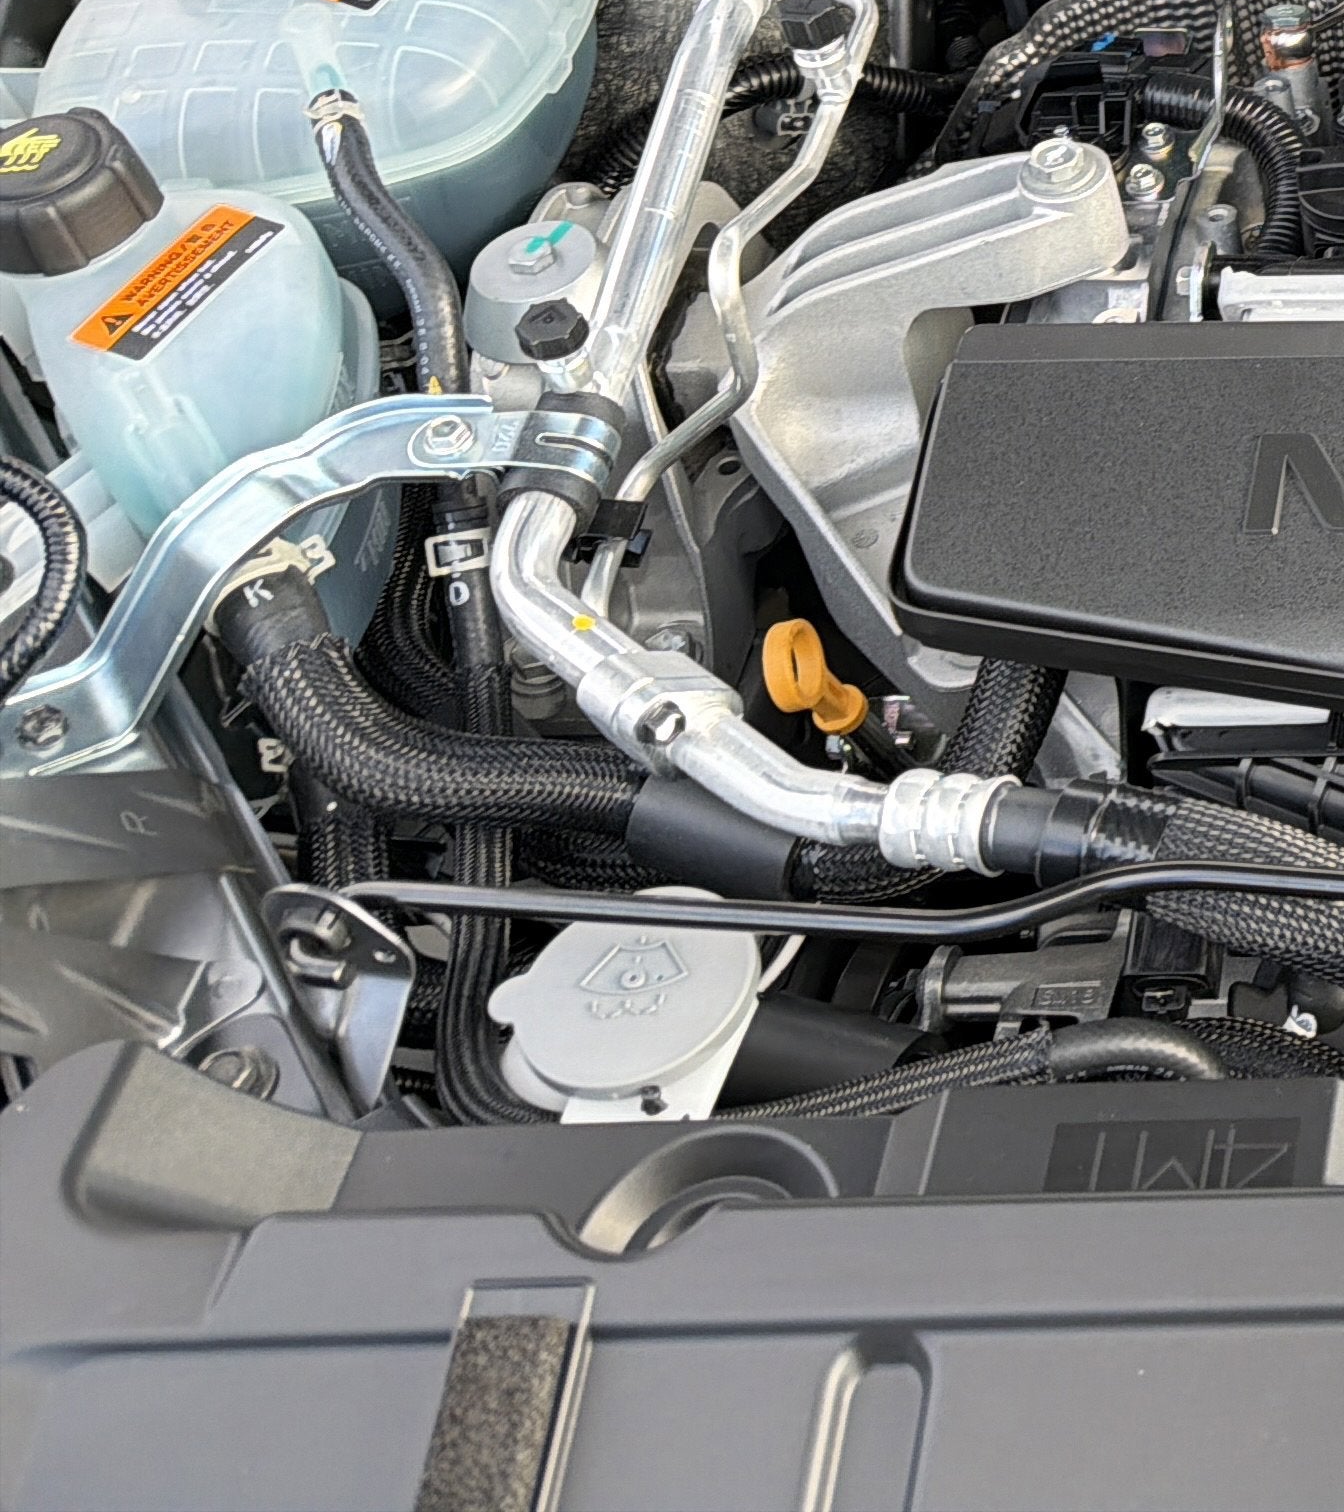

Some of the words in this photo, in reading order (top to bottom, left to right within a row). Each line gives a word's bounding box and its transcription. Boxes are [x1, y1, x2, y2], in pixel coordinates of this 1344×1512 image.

[121, 251, 181, 303] WARNING
[134, 219, 236, 308] AVERTISSEMENT
[242, 578, 275, 608] K
